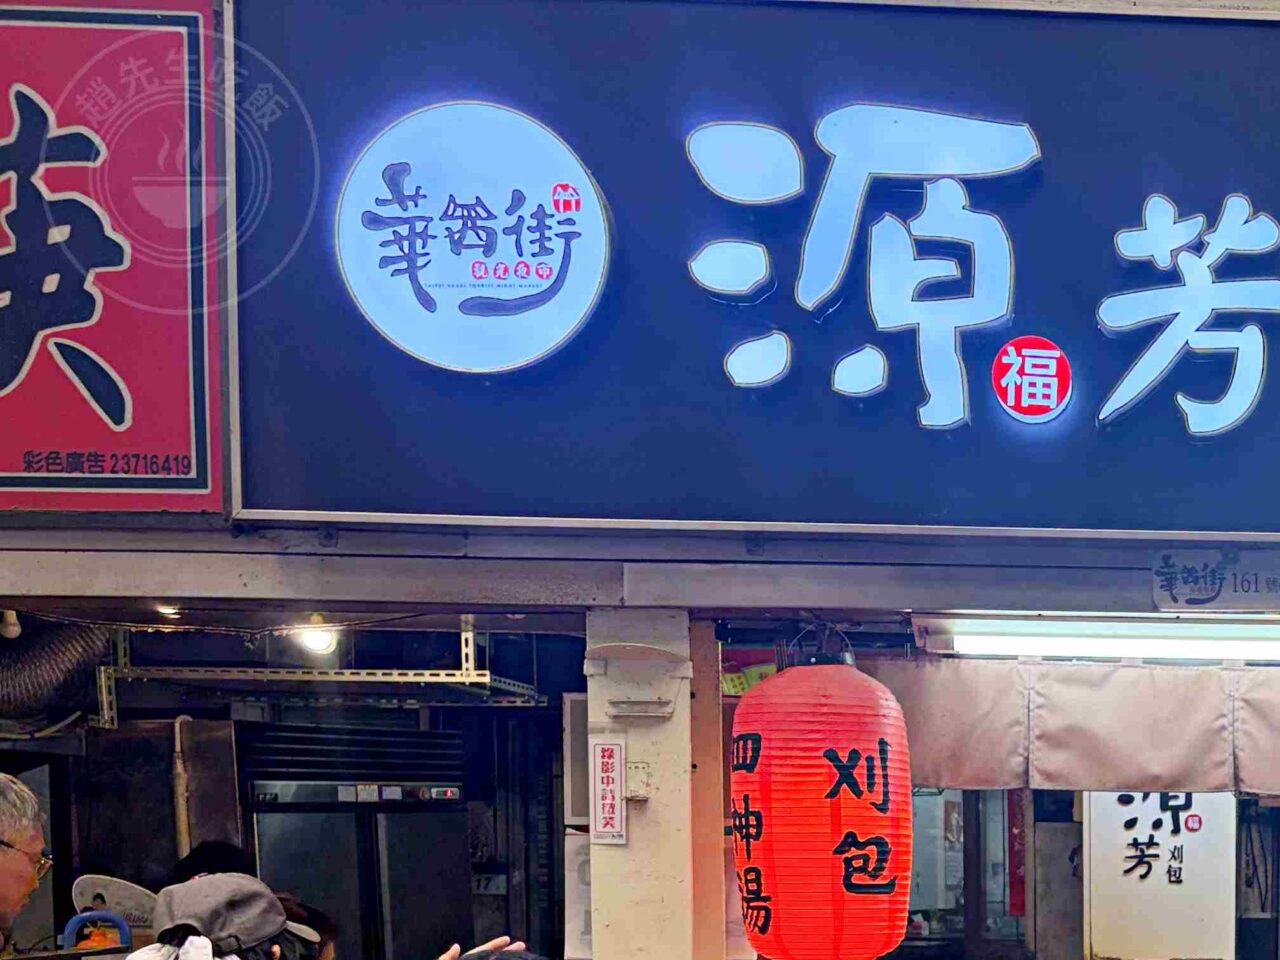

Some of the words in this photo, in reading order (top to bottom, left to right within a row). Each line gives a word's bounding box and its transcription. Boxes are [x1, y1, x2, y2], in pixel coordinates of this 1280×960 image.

[361, 162, 582, 317] 華西街
[1001, 346, 1062, 408] 福
[23, 450, 106, 474] 彩色廣告
[109, 453, 192, 477] 23716419
[1231, 572, 1260, 594] 161
[823, 738, 897, 894] 刈包
[1167, 844, 1184, 884] 刈包
